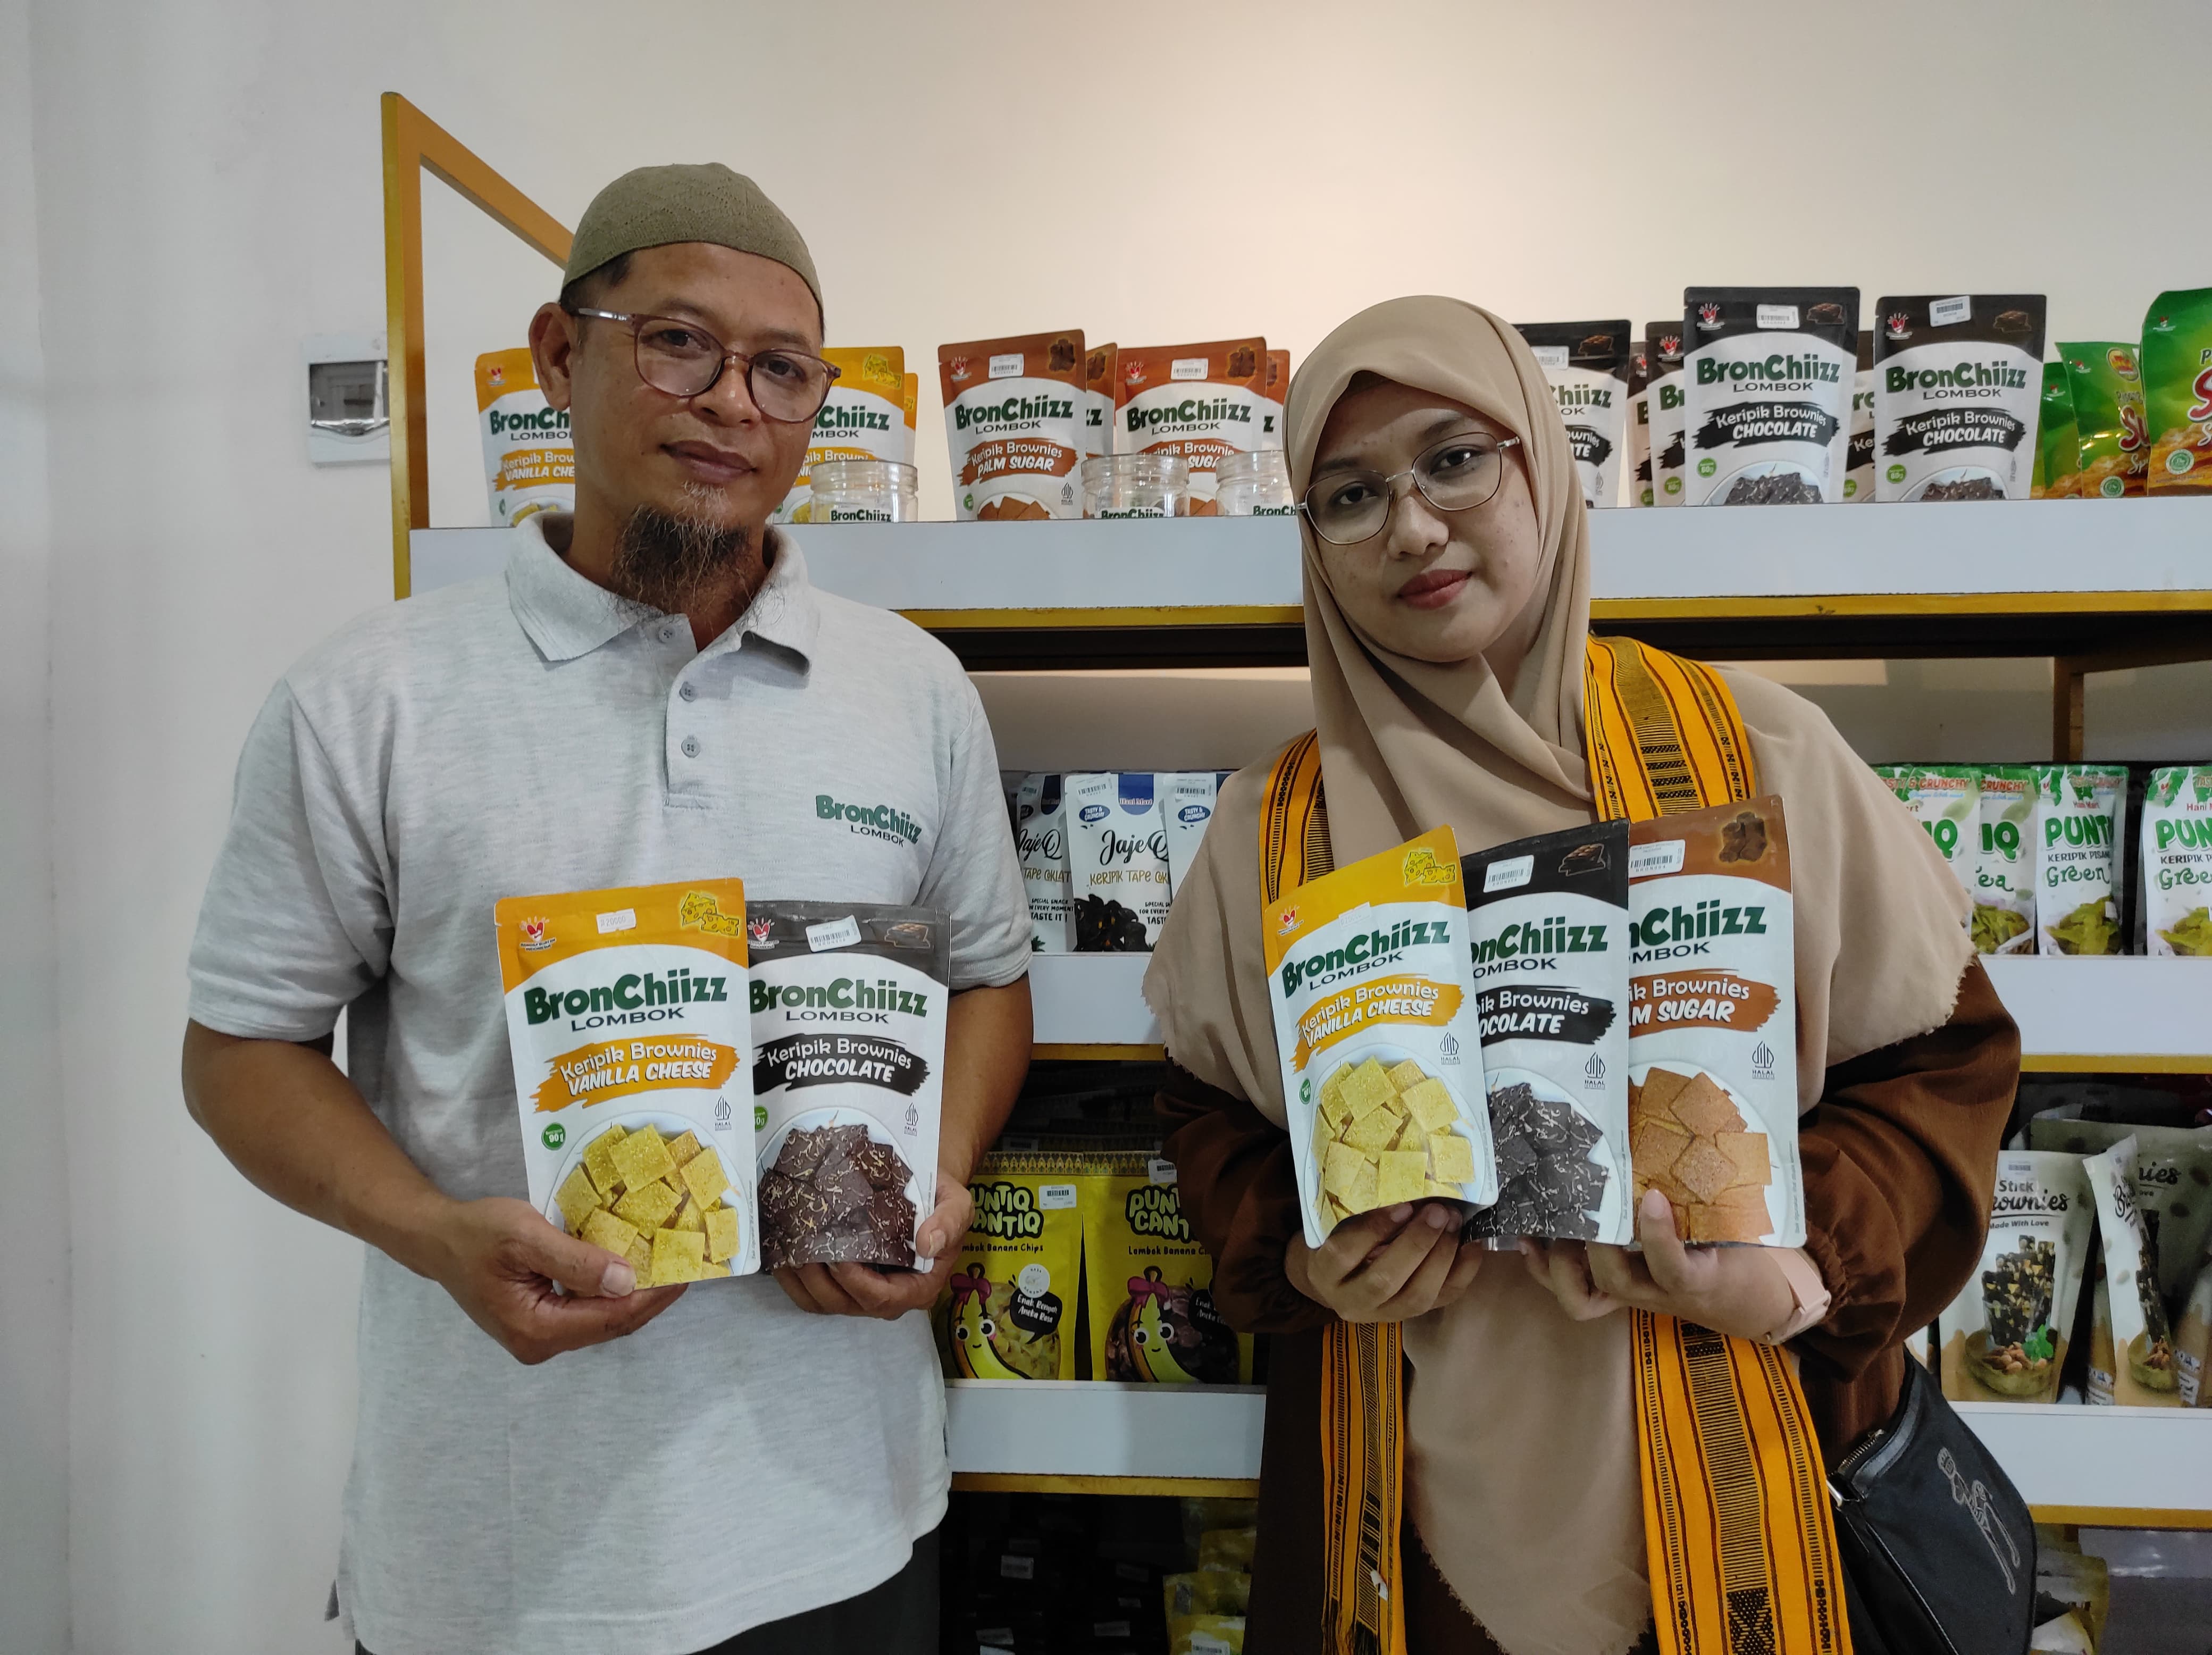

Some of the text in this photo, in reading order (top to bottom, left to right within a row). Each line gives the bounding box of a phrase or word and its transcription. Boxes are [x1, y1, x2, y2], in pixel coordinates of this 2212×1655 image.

[1697, 354, 1839, 385] BronChiizz
[1886, 361, 2026, 394] BronChiizz
[1733, 382, 1814, 392] LOMBOK
[1923, 389, 2001, 400] LOMBOK
[490, 407, 569, 435] BronCh
[815, 405, 890, 431] Chiizz
[955, 395, 1073, 431] BronChiizz
[1127, 398, 1251, 432] BronChiizz
[1715, 405, 1826, 429] Keripik Brownies
[1906, 411, 2015, 436] Keripik Brownies
[975, 420, 1041, 435] LOMBOK
[1151, 422, 1221, 436] LOMBOK
[1732, 421, 1817, 439] CHOCOLATE
[1923, 427, 2006, 447] CHOCOLATE
[544, 451, 575, 463] Brow
[971, 441, 1063, 467] Keripik Brownies
[1184, 442, 1234, 456] Brownie
[506, 466, 575, 481] VANILLA CHE
[977, 456, 1054, 478] PALM SUGAR
[1188, 455, 1218, 469] SUG
[831, 508, 892, 522] BronChiizz
[1253, 505, 1296, 516] BronCh
[1920, 778, 1970, 790] CRUNCHY
[1980, 779, 2027, 792] CRUNCHY
[816, 795, 923, 845] BronChiizz
[2045, 814, 2112, 848] PUNT
[850, 825, 904, 847] LOMBOK
[2155, 819, 2212, 849] PUN
[2048, 851, 2110, 863] KERIPIK PISAN
[2160, 854, 2203, 865] KERIPIK
[2046, 866, 2110, 888] Green
[2159, 867, 2212, 890] Gree
[1030, 912, 1053, 921] TASTE
[1629, 899, 1767, 948] nChiizz
[1471, 916, 1608, 964] onChiizz
[1282, 920, 1450, 999] BronChiizz
[1631, 941, 1711, 964] MBOK
[1309, 951, 1403, 991] LOMBOK
[1473, 958, 1557, 979] OMBOK
[524, 968, 727, 1025] BronChiizz
[749, 977, 928, 1018] BronChiizz
[1652, 977, 1750, 1000] Brownies
[1302, 982, 1439, 1038] Keripik Brownies
[1499, 990, 1589, 1014] Brownies
[1657, 998, 1735, 1022] SUGAR
[571, 1007, 684, 1032] LOMBOK
[786, 1010, 890, 1024] LOMBOK
[1305, 999, 1434, 1049] VANILLA CHEESE
[1479, 1012, 1565, 1038] OCOLATE
[560, 1042, 717, 1082] Keripik Brownies
[767, 1037, 912, 1070] Keripik Brownies
[568, 1061, 713, 1097] VANILLA CHEESE
[785, 1058, 895, 1083] CHOCOLATE
[972, 1185, 1030, 1212] UNTIQ
[1999, 1180, 2034, 1193] Stick
[1129, 1187, 1180, 1217] PUNT
[973, 1210, 1041, 1236] ANTIQ
[1135, 1210, 1189, 1240] CANT
[961, 1243, 1043, 1254] mbok Banana Chips
[1163, 1246, 1201, 1255] Banana
